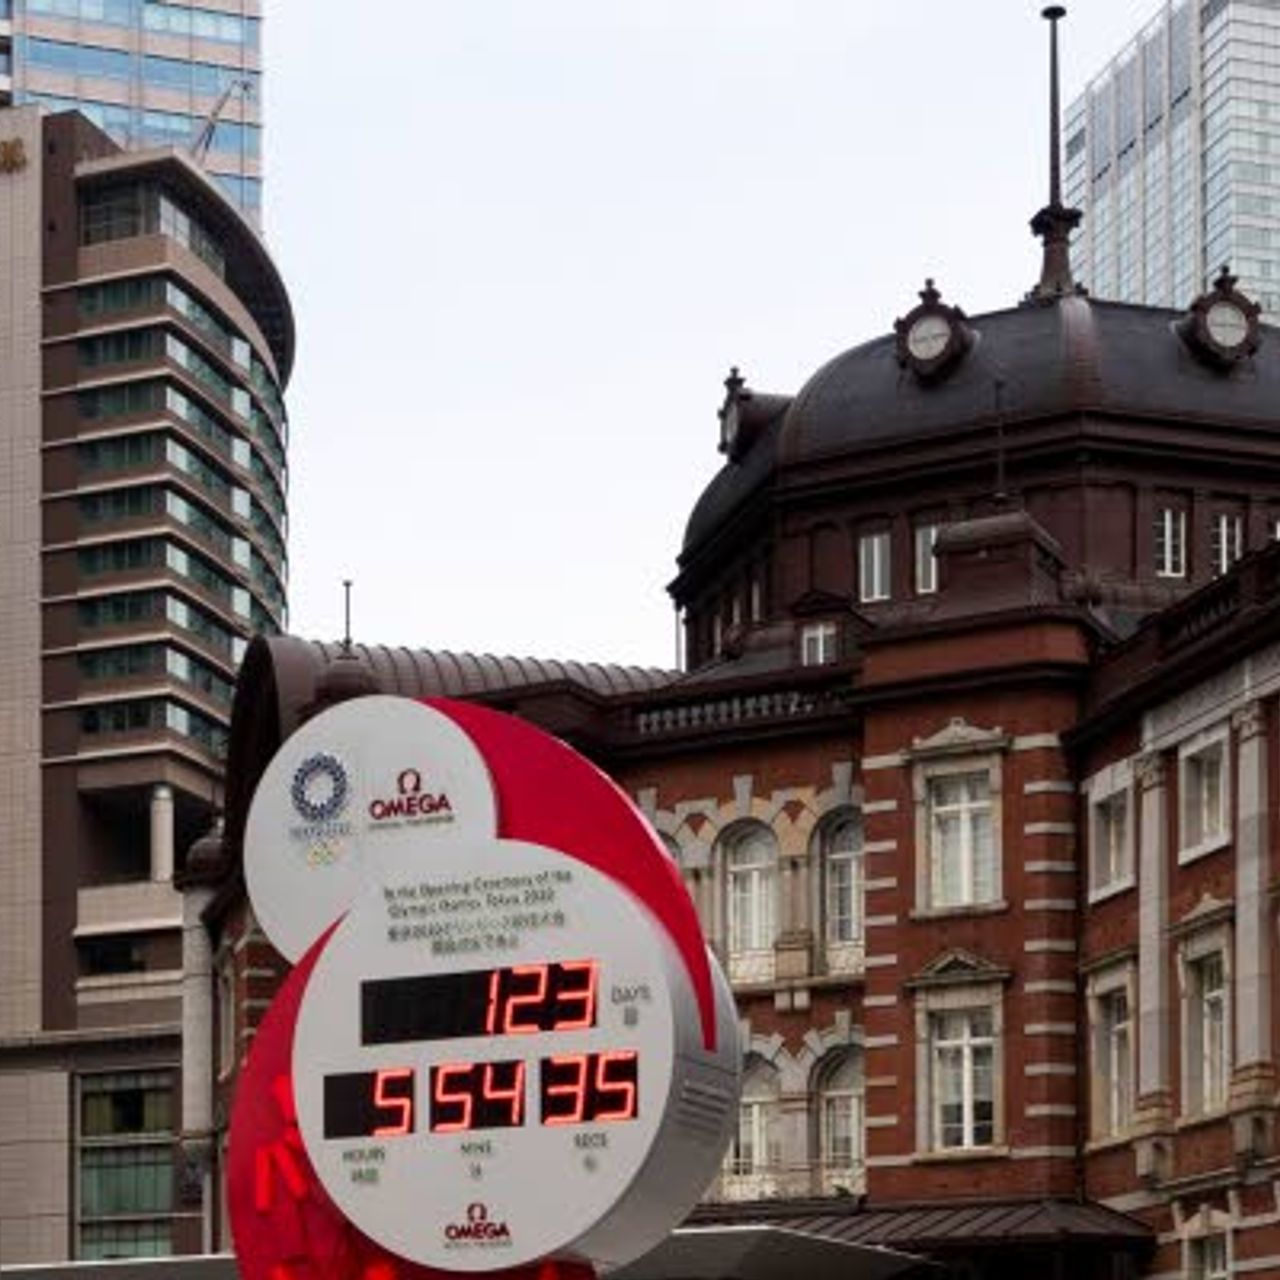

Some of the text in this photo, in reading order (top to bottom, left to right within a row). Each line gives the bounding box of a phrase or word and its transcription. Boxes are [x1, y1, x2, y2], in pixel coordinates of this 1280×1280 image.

[370, 793, 452, 820] OMEGA
[486, 959, 597, 1034] 123
[611, 984, 651, 1004] DAYS
[374, 1051, 637, 1137] 5 54 35
[444, 1222, 510, 1241] OMEGA
